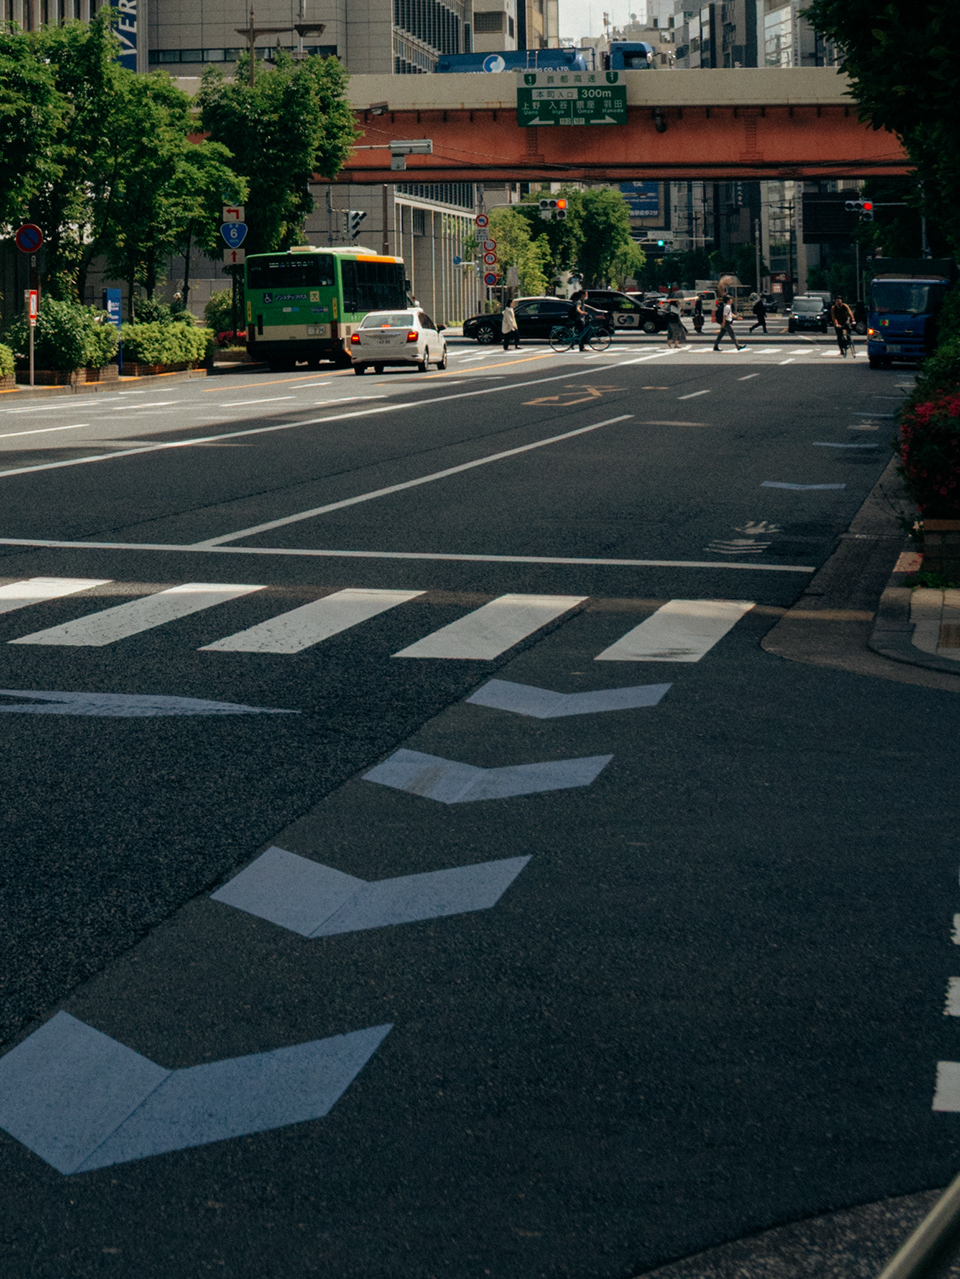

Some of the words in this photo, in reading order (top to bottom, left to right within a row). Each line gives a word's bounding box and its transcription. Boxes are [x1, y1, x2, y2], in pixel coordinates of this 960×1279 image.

[547, 74, 596, 84] 首都高速
[536, 90, 574, 99] 本町入口
[581, 89, 612, 98] 300m
[522, 101, 541, 110] 上野
[549, 100, 568, 109] 入谷
[576, 100, 595, 109] 銀座
[603, 99, 623, 108] 羽田
[230, 228, 238, 238] 6
[617, 315, 634, 325] GO
